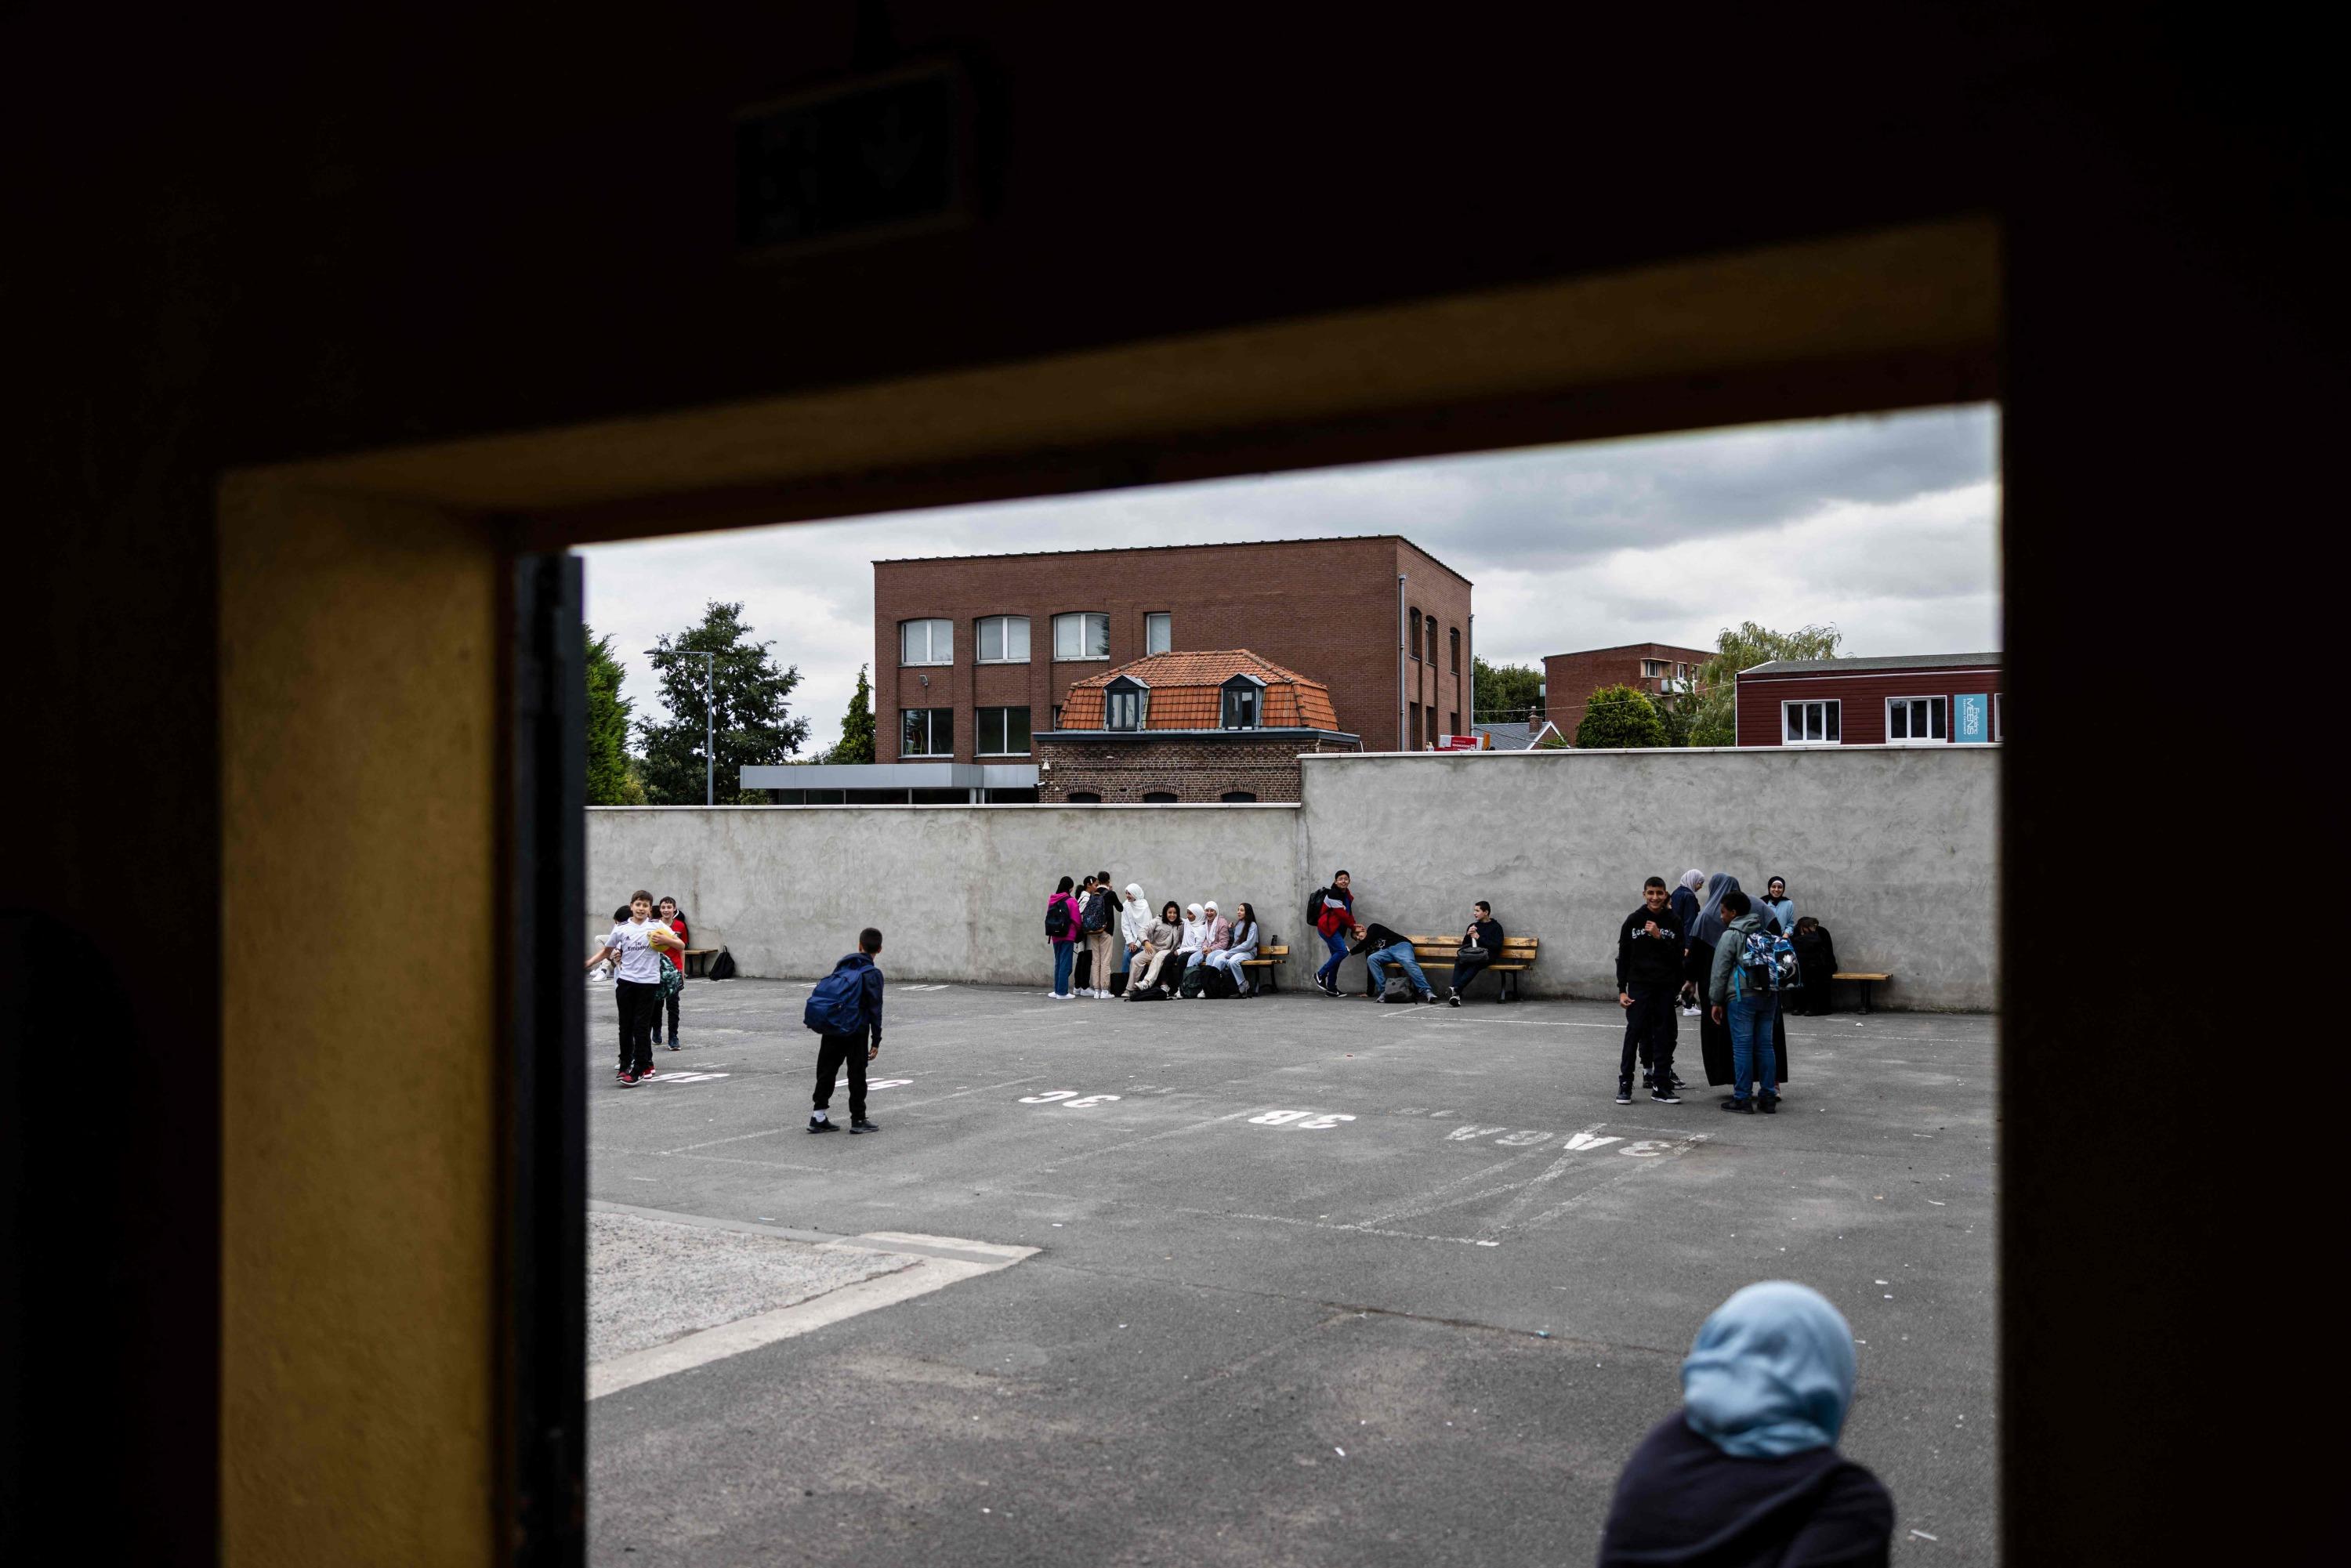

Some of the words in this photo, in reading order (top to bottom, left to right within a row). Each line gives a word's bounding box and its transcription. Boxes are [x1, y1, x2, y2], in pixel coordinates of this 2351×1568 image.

[1018, 1091, 1121, 1108] 3C
[1248, 1110, 1357, 1128] 3B
[1563, 1133, 1672, 1157] 3A
